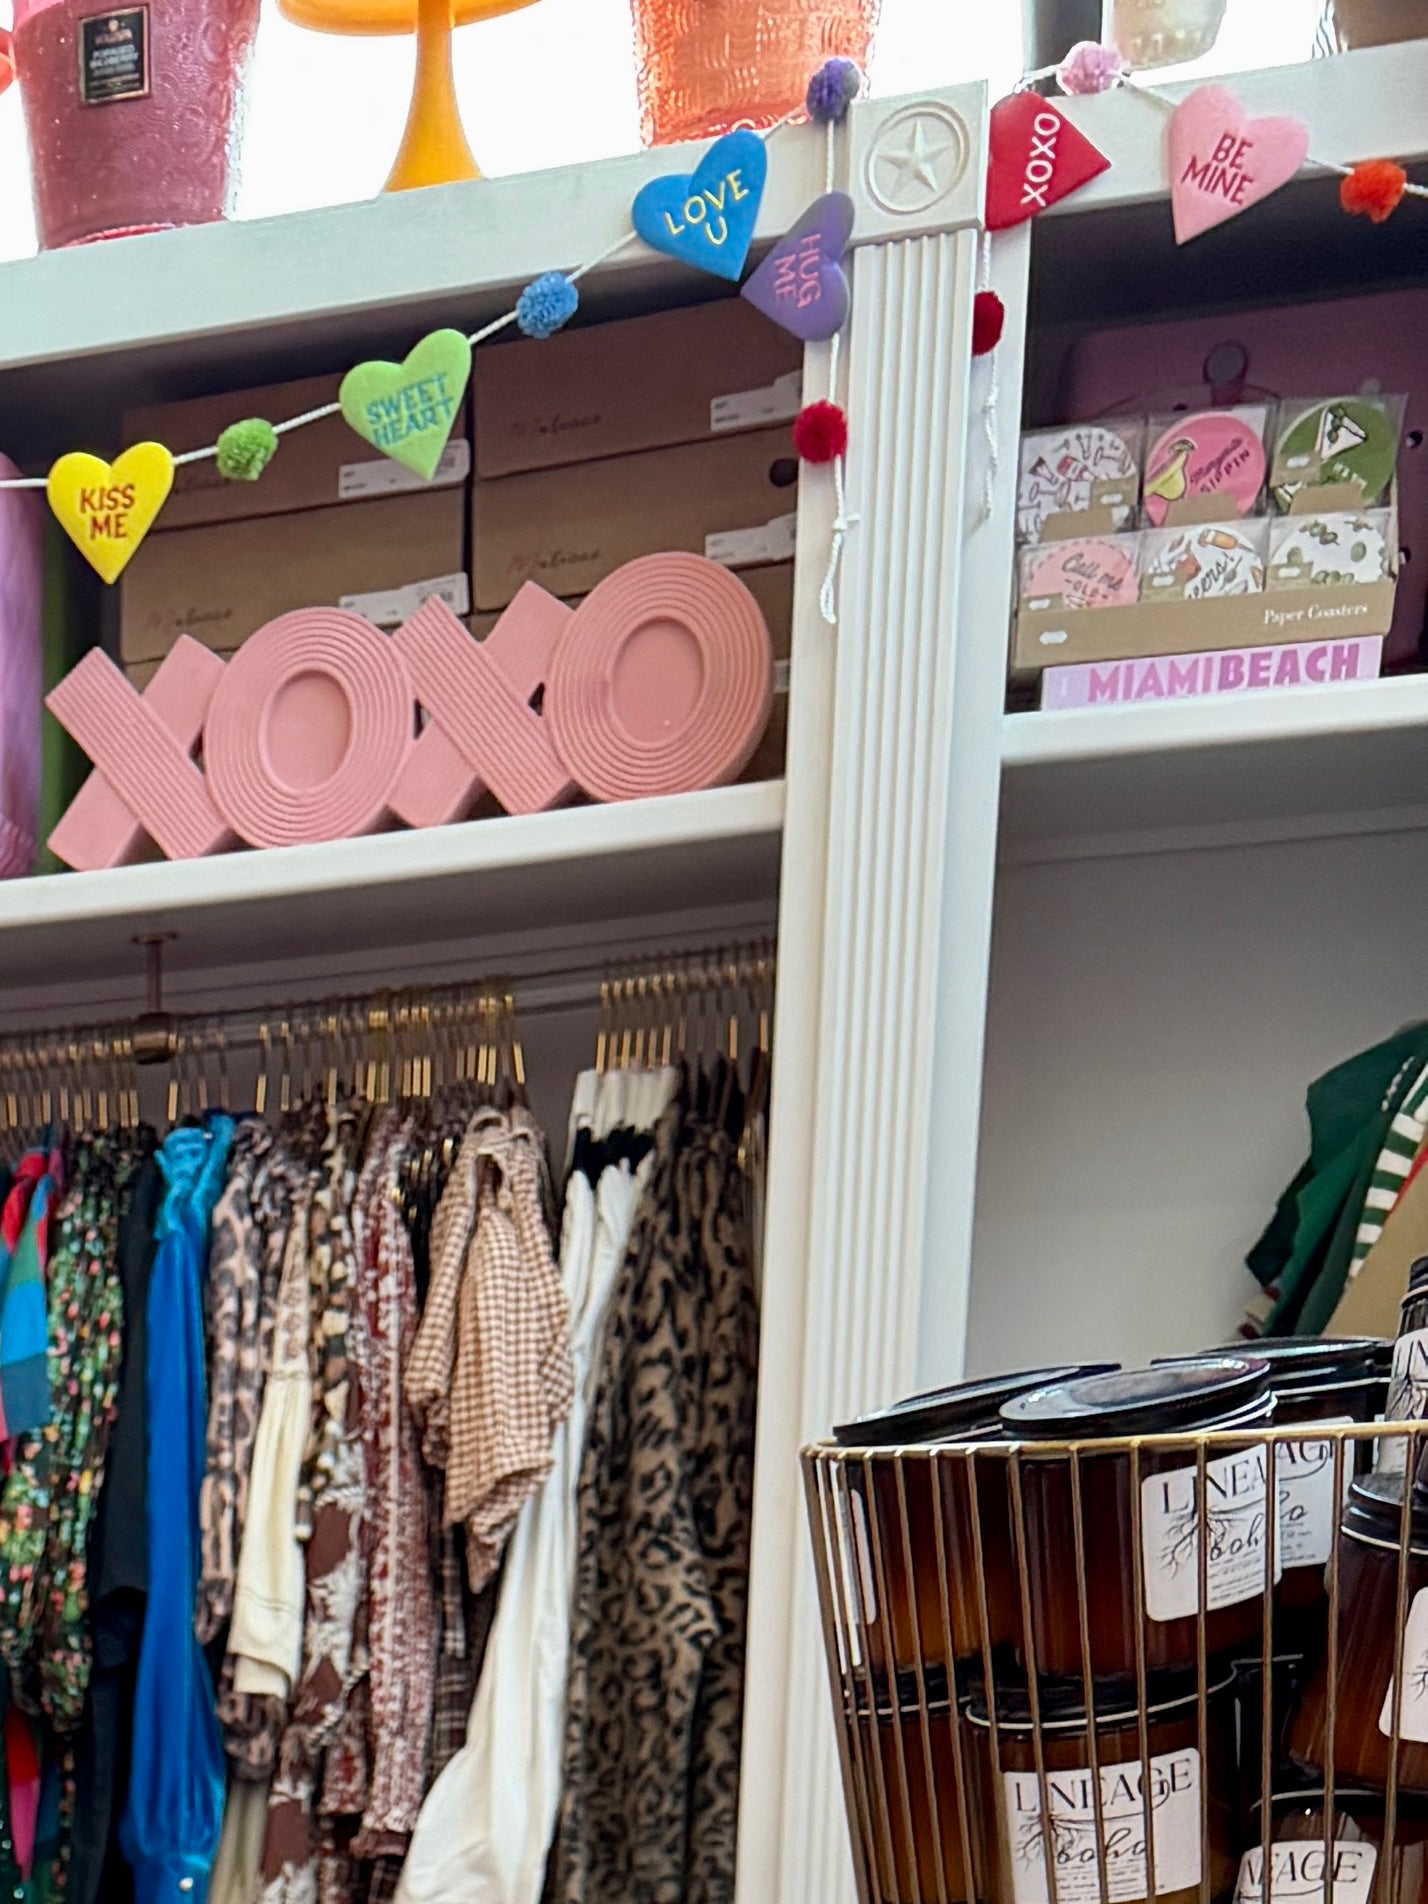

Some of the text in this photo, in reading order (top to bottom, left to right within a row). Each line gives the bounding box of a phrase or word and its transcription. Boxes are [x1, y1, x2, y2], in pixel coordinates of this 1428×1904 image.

[1020, 112, 1061, 207] XOXO
[1211, 132, 1254, 170] BE
[664, 168, 750, 236] LOVE
[1180, 155, 1254, 206] MINE
[705, 216, 728, 245] U
[774, 254, 797, 301] ME
[797, 234, 822, 308] HUG
[366, 372, 448, 425] SWEET
[372, 397, 453, 447] HEART
[79, 484, 137, 514] KISS
[89, 513, 128, 541] ME
[1263, 602, 1369, 627] Paper Coasters
